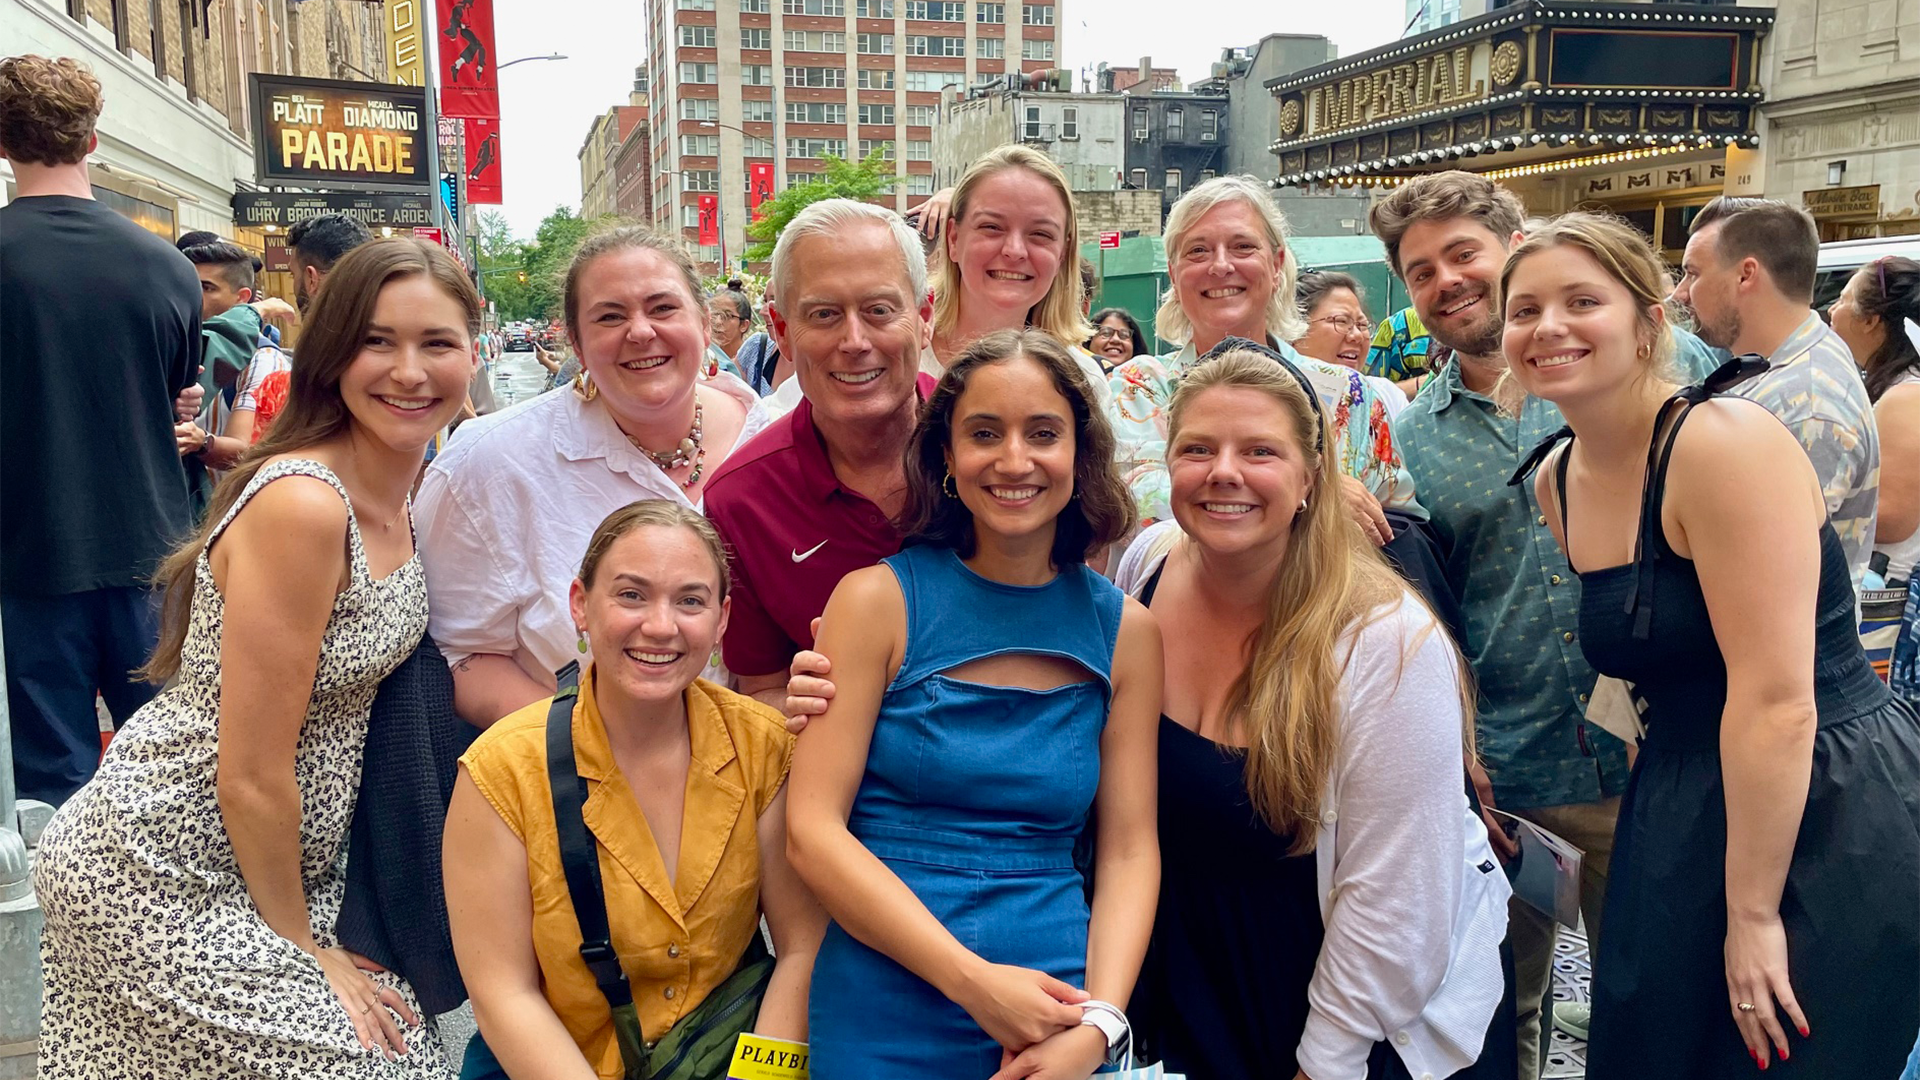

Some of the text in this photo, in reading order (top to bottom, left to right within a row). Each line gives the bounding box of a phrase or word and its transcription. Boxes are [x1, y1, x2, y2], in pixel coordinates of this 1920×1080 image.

[291, 94, 305, 103] BEN
[1313, 47, 1484, 133] IMPERIAL
[273, 101, 325, 125] PLATT
[367, 100, 394, 110] MICAELA
[343, 107, 419, 131] DIAMOND
[281, 128, 415, 175] PARADE
[1808, 188, 1873, 205] Music Box
[246, 207, 281, 222] UHRY
[1833, 202, 1874, 213] ENTRANCE
[739, 1045, 809, 1070] PLAYBI
